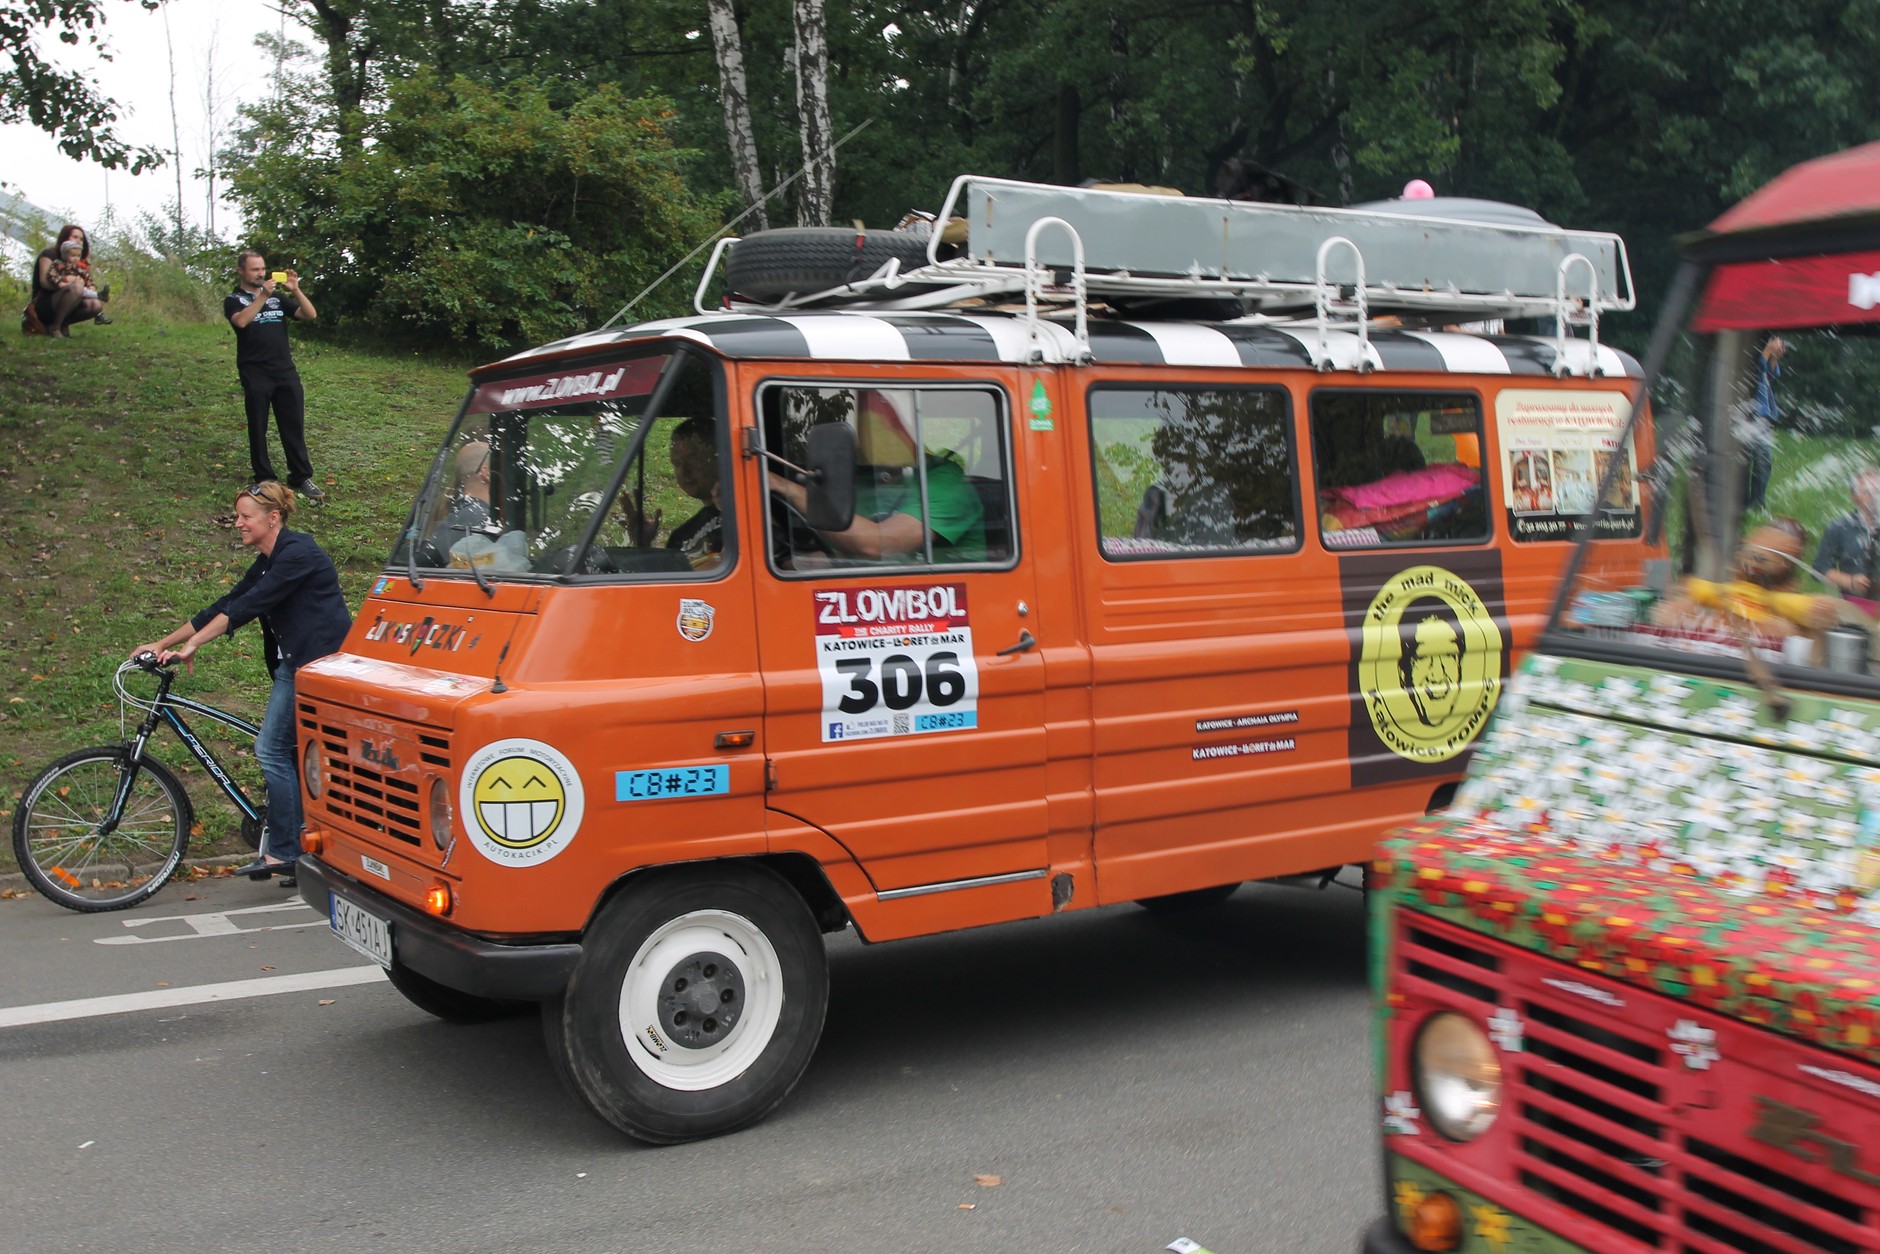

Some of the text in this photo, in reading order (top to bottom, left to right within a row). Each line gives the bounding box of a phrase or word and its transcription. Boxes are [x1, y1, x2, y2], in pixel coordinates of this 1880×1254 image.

[1372, 572, 1479, 622] the mad mick
[869, 625, 906, 636] CHARITY
[908, 623, 935, 634] RALLY
[940, 634, 965, 645] MAR
[836, 652, 966, 714] 306
[184, 733, 231, 785] MERIDA
[498, 747, 525, 756] FORUM
[629, 768, 717, 798] CB#23
[483, 839, 558, 859] AUTOKACIK.PL
[336, 899, 352, 937] SK
